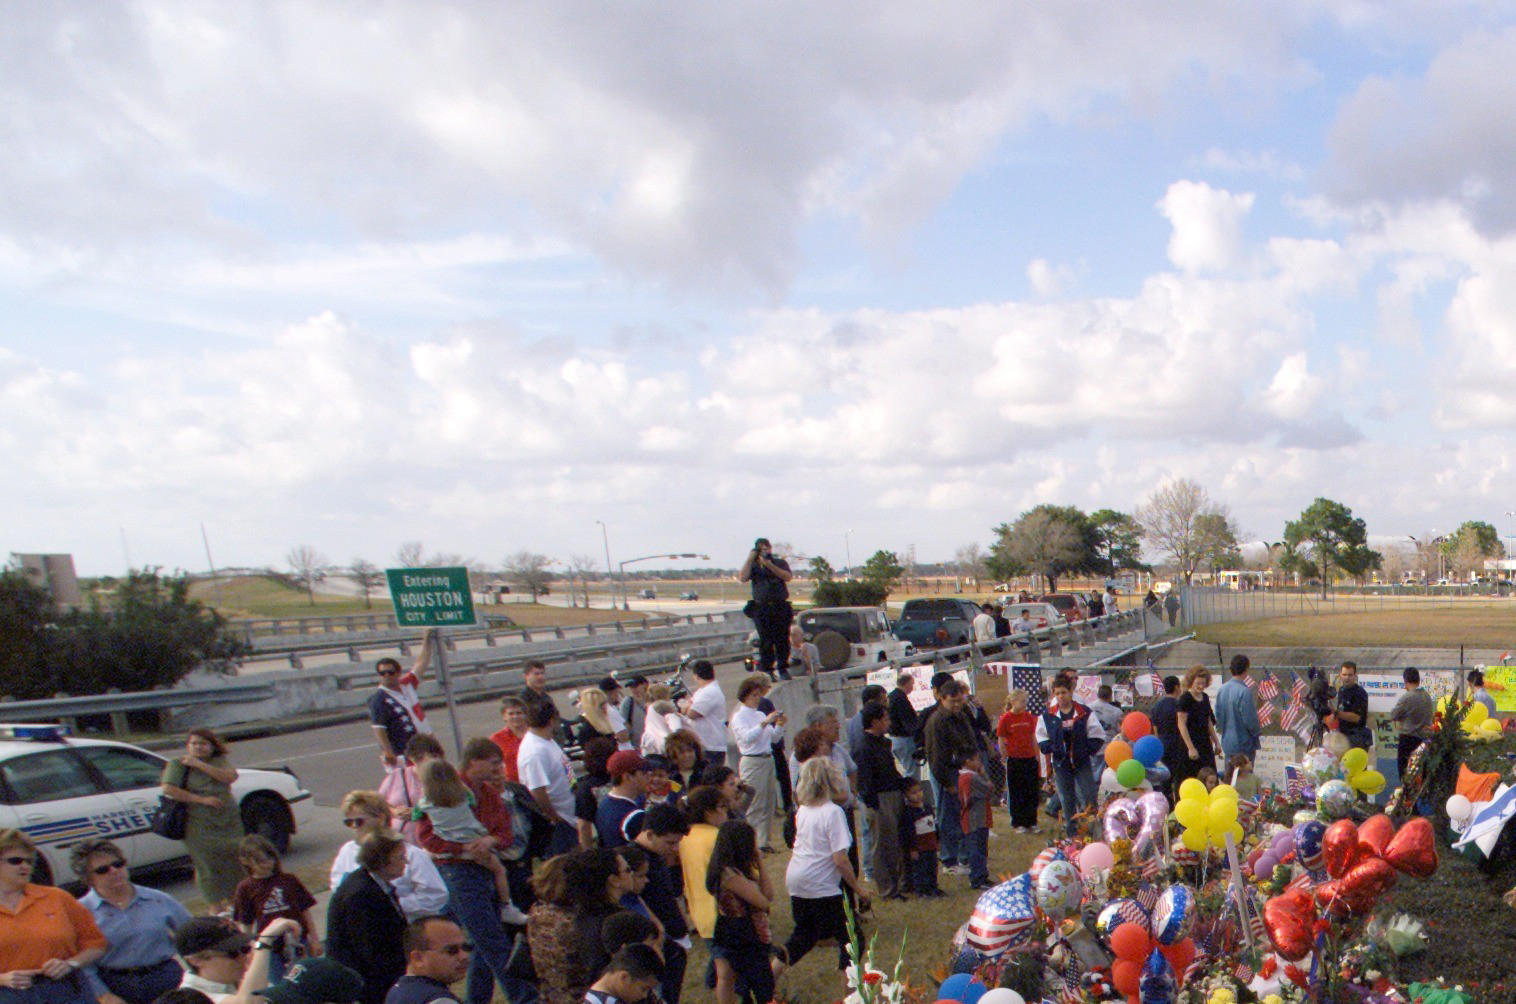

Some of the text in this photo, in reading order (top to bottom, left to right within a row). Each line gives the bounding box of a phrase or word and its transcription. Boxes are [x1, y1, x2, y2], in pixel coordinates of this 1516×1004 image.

[403, 575, 449, 589] Entering
[400, 591, 463, 607] HOUSTON
[406, 610, 463, 621] CITY LIMIT
